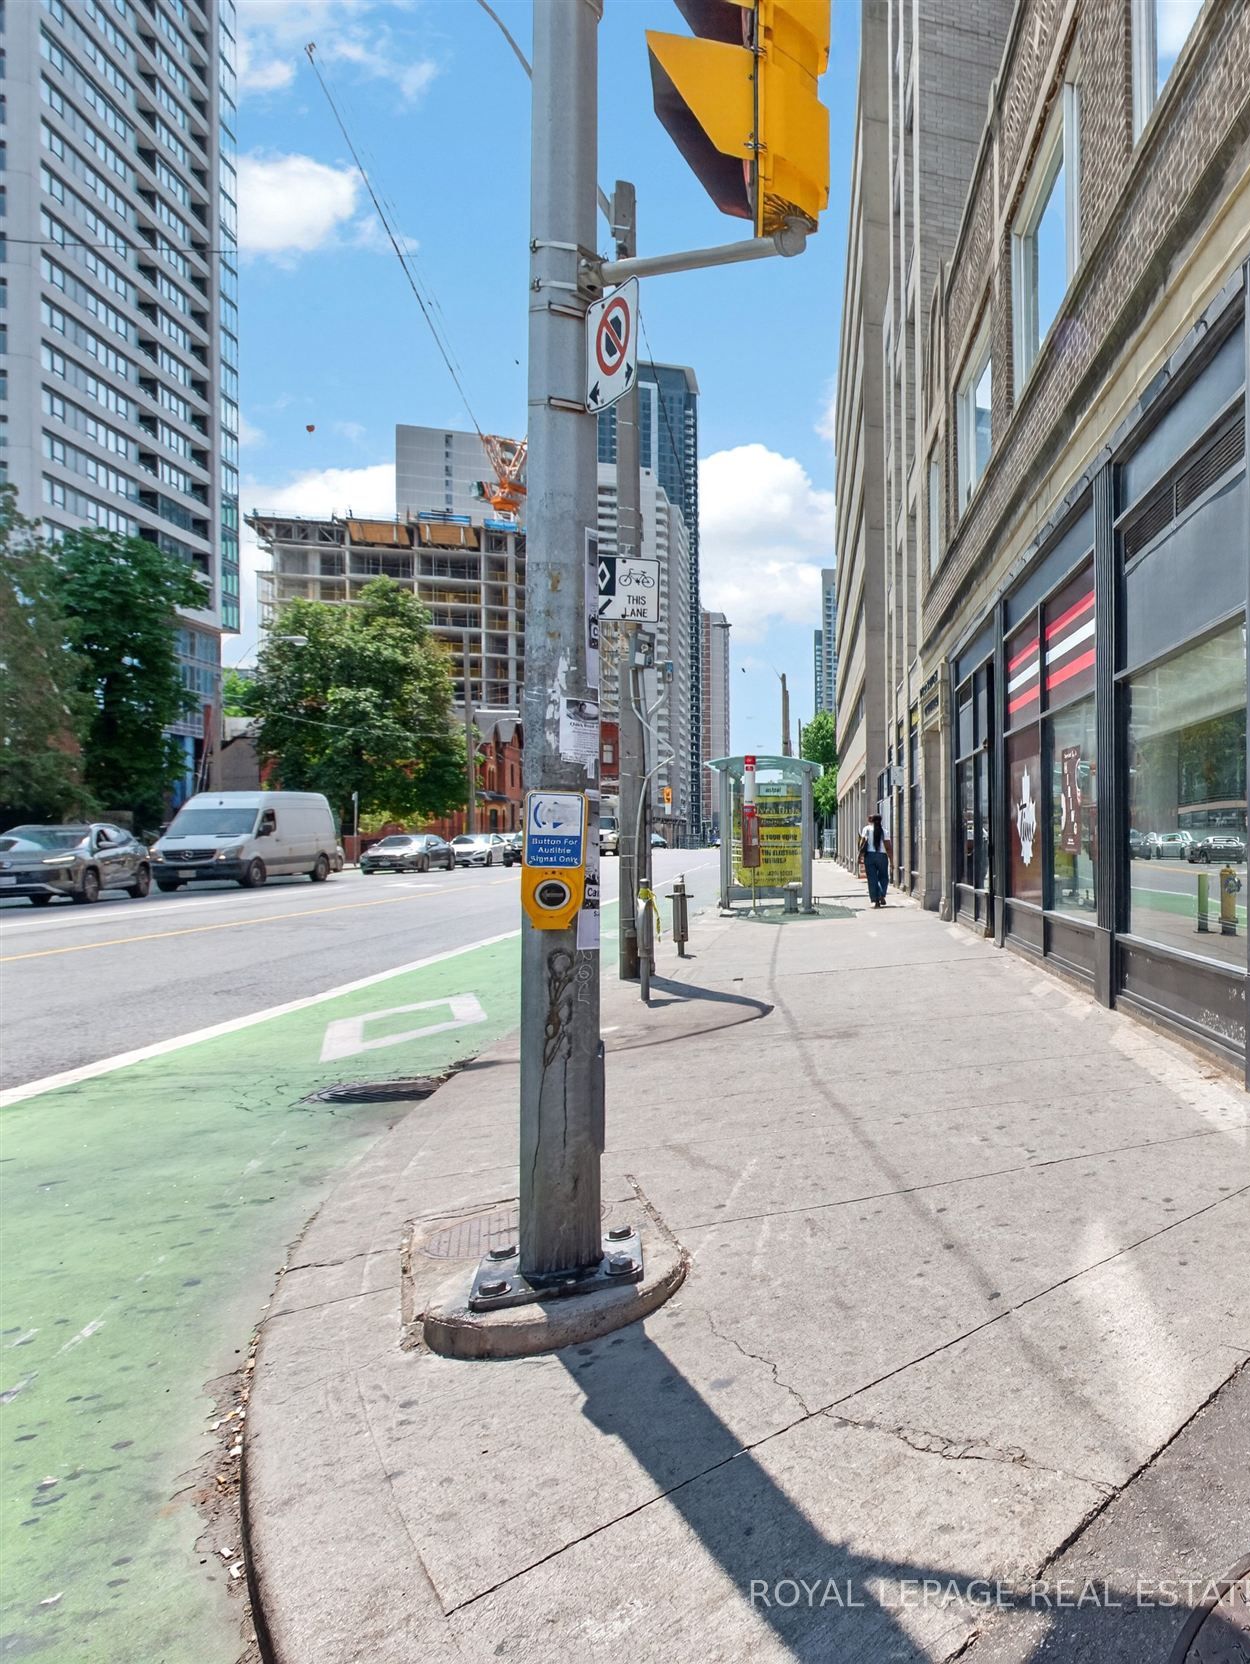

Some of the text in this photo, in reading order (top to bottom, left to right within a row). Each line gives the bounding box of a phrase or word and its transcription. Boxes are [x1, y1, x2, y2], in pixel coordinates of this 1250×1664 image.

[627, 595, 647, 606] THIS
[625, 608, 648, 618] LANE
[538, 846, 571, 854] Audible
[530, 855, 578, 864] Signal Only
